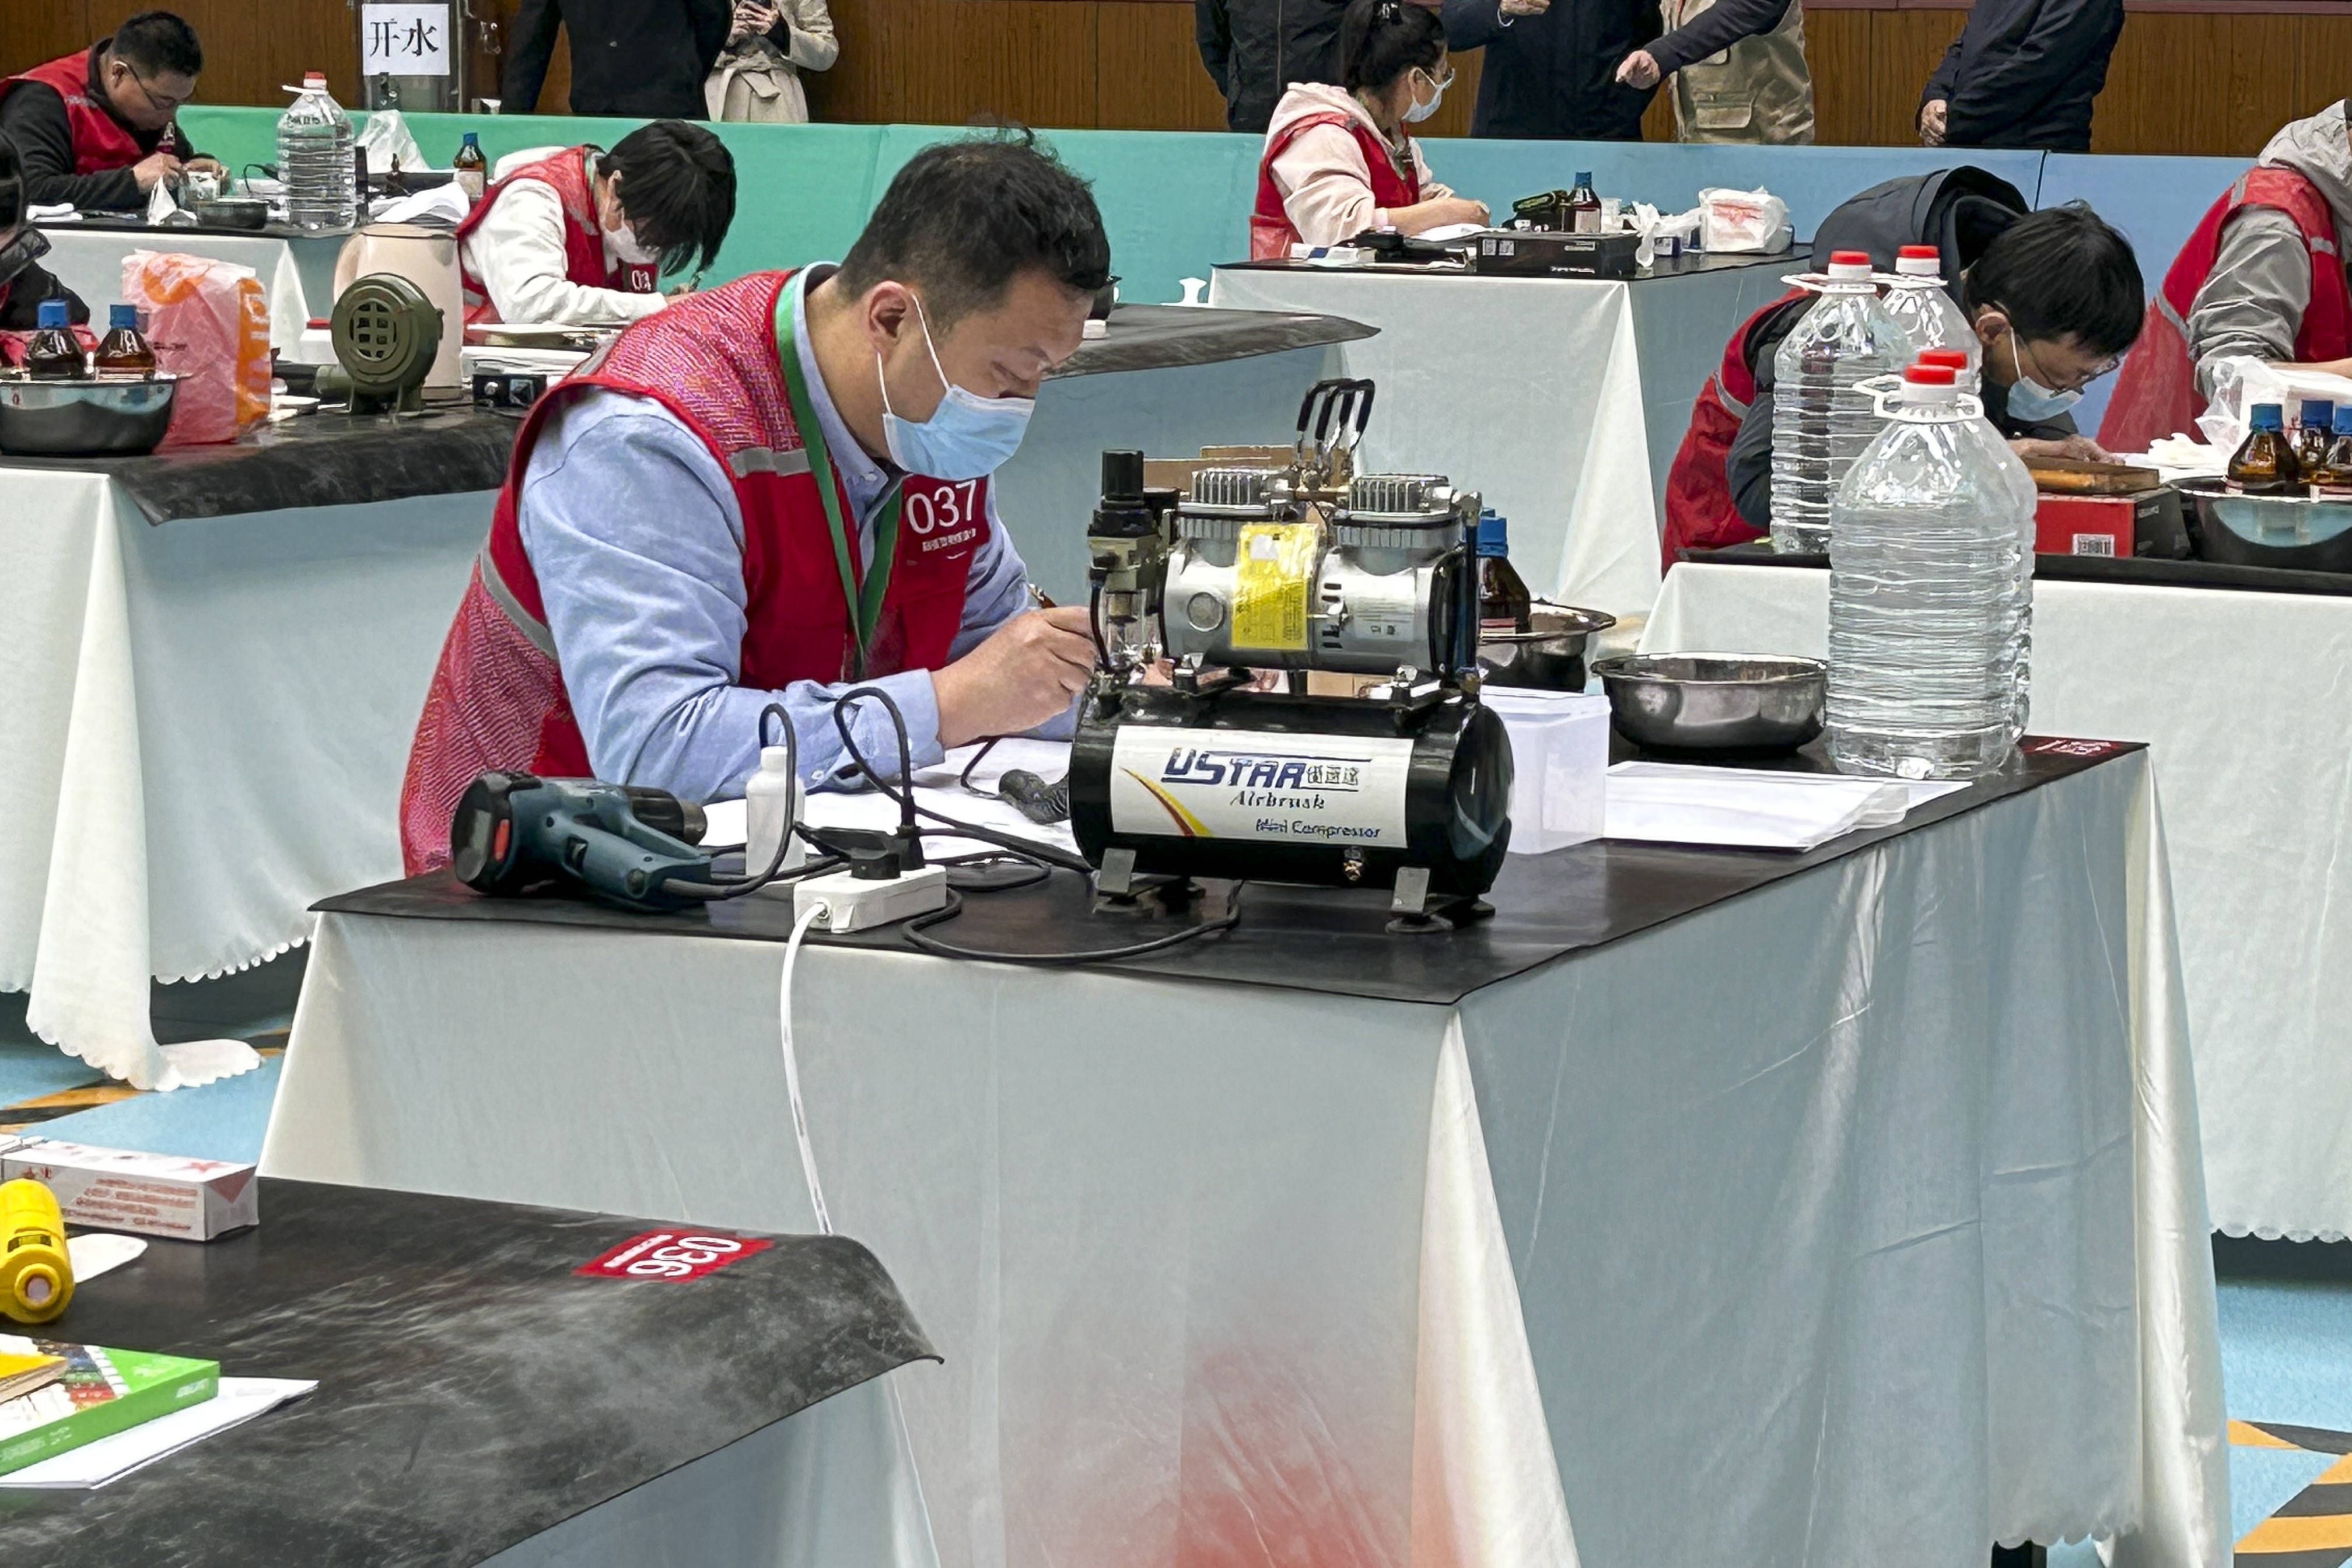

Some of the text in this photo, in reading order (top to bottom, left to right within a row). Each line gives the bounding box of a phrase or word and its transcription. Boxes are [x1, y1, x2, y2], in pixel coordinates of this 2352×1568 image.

[367, 18, 439, 57] 开水
[906, 480, 977, 534] 037
[626, 1236, 742, 1277] 036
